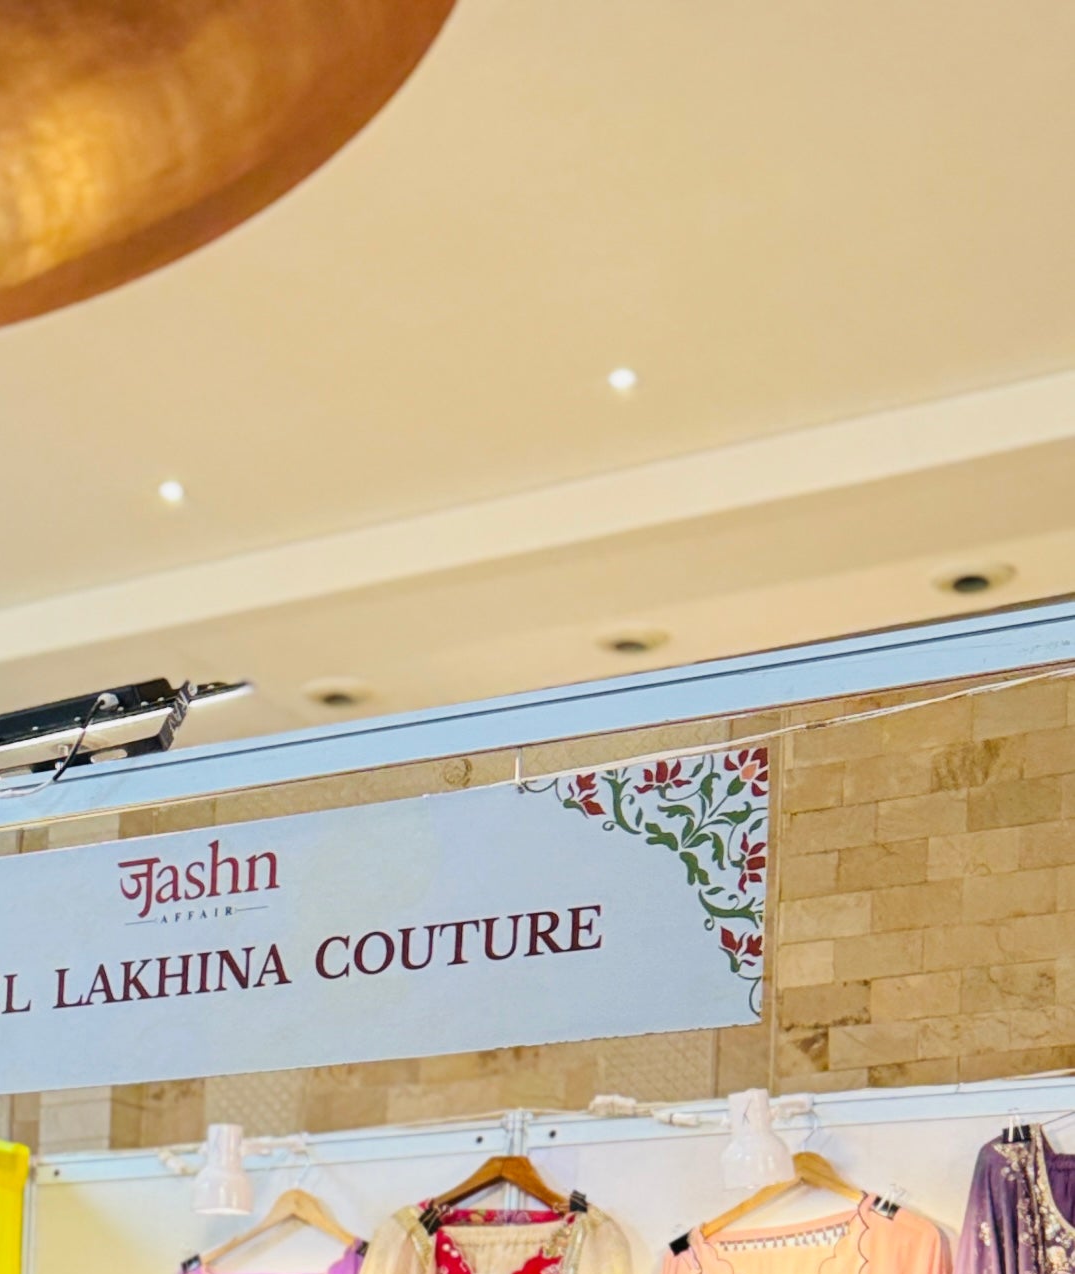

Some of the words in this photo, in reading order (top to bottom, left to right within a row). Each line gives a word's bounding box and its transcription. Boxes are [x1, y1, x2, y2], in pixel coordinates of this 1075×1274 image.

[160, 906, 233, 924] AFFAIR
[52, 943, 292, 1010] LAKHINA
[315, 904, 603, 980] COUTURE
